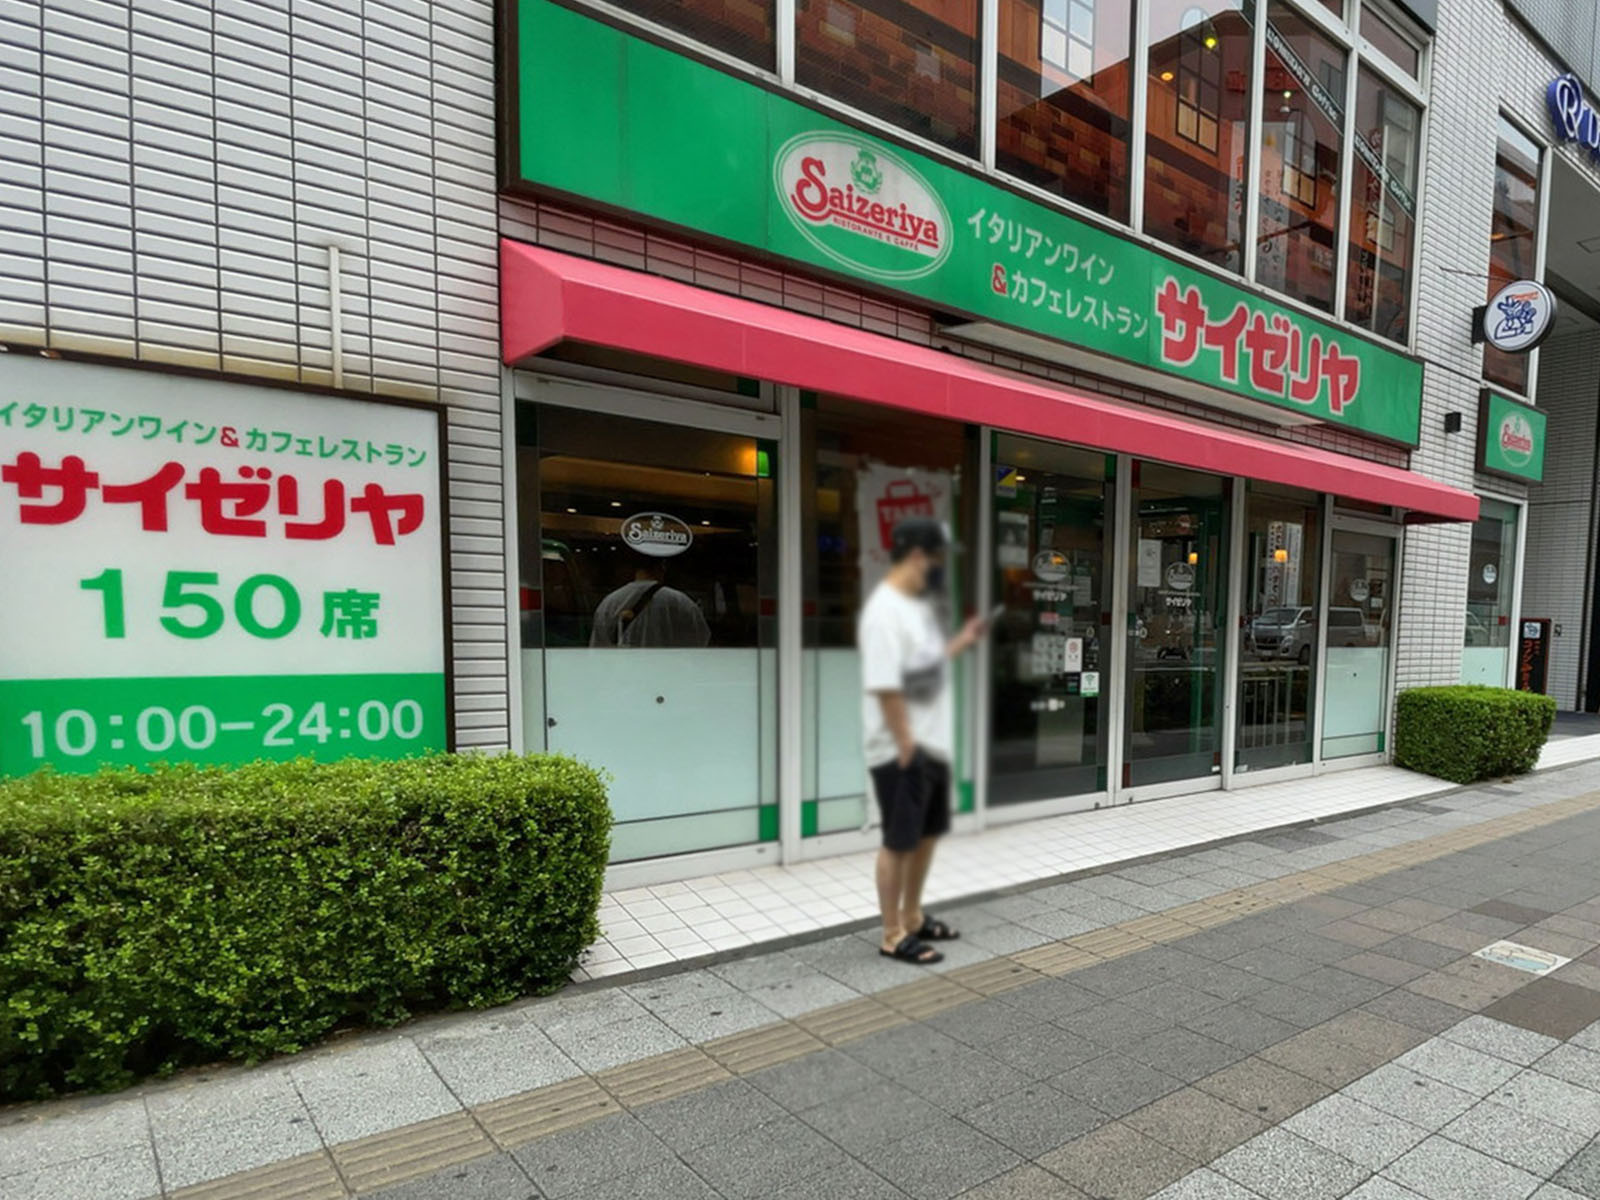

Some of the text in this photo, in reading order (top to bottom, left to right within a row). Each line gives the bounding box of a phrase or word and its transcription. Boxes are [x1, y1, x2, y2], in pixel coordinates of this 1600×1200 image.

[791, 156, 939, 250] Saizeriya
[968, 208, 1114, 285] イタリアンワイン
[1156, 276, 1360, 416] サイゼリヤ
[1, 451, 424, 546] サイゼリヤ
